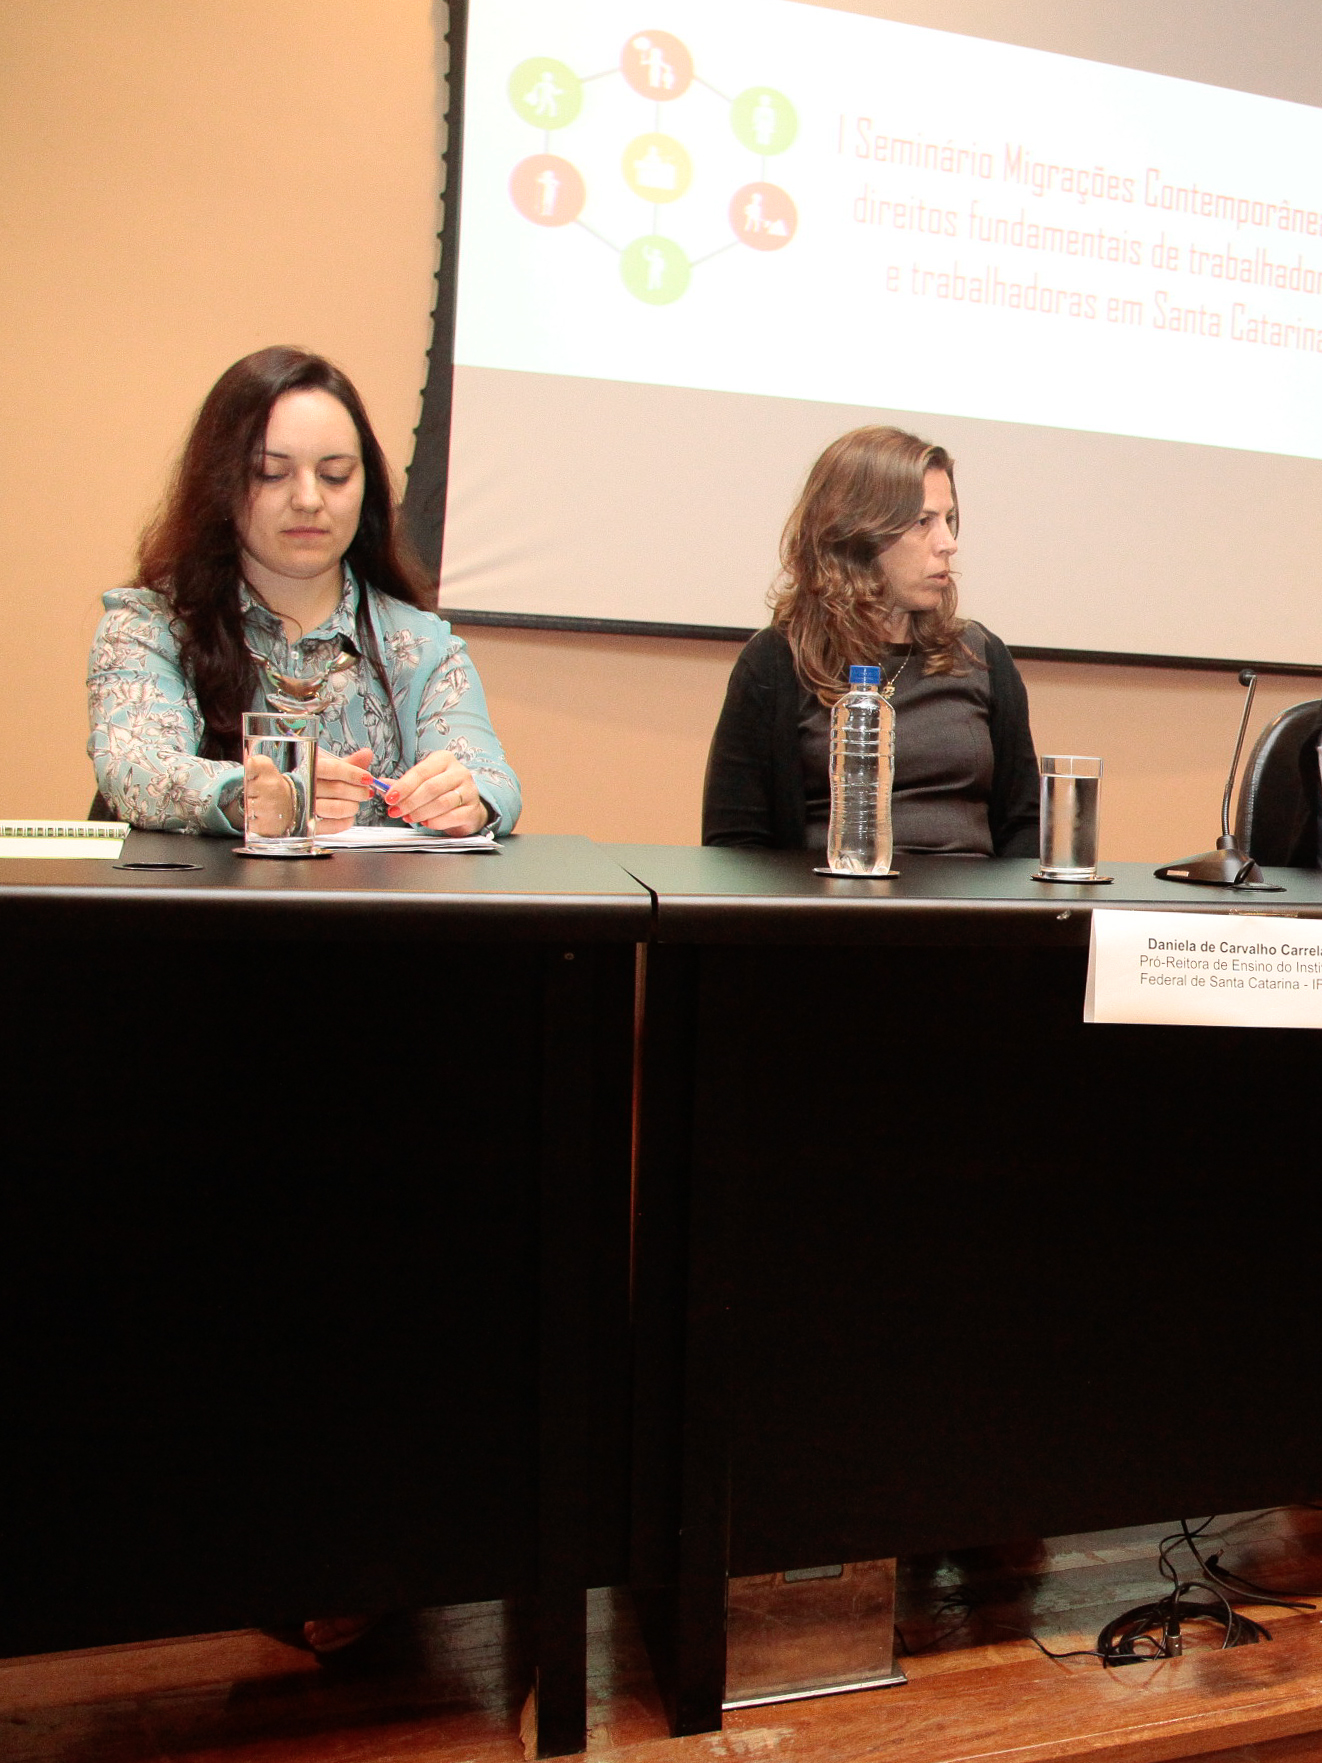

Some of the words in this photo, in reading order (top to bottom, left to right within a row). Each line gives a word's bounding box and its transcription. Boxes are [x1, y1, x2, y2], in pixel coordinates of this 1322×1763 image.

[836, 114, 846, 155] I
[855, 116, 994, 181] Seminário
[1003, 143, 1135, 205] Migrações
[852, 183, 958, 238] direitos
[968, 200, 1142, 266] fundamentais
[1151, 231, 1179, 272] de
[886, 264, 901, 294] e
[911, 260, 1097, 321] trabalhadoras
[1106, 296, 1143, 327] em
[1153, 290, 1222, 339] Santa
[1140, 954, 1210, 971] Pró-Reitora
[1213, 958, 1228, 972] de
[1232, 959, 1273, 973] Ensino
[1276, 960, 1292, 973] do
[1147, 938, 1197, 952] Daniela
[1200, 940, 1216, 954] de
[1219, 941, 1277, 956] Carvalho
[1140, 972, 1187, 987] Federal
[1190, 974, 1206, 988] de
[1209, 976, 1245, 990] Santa
[1248, 977, 1300, 991] Catarina
